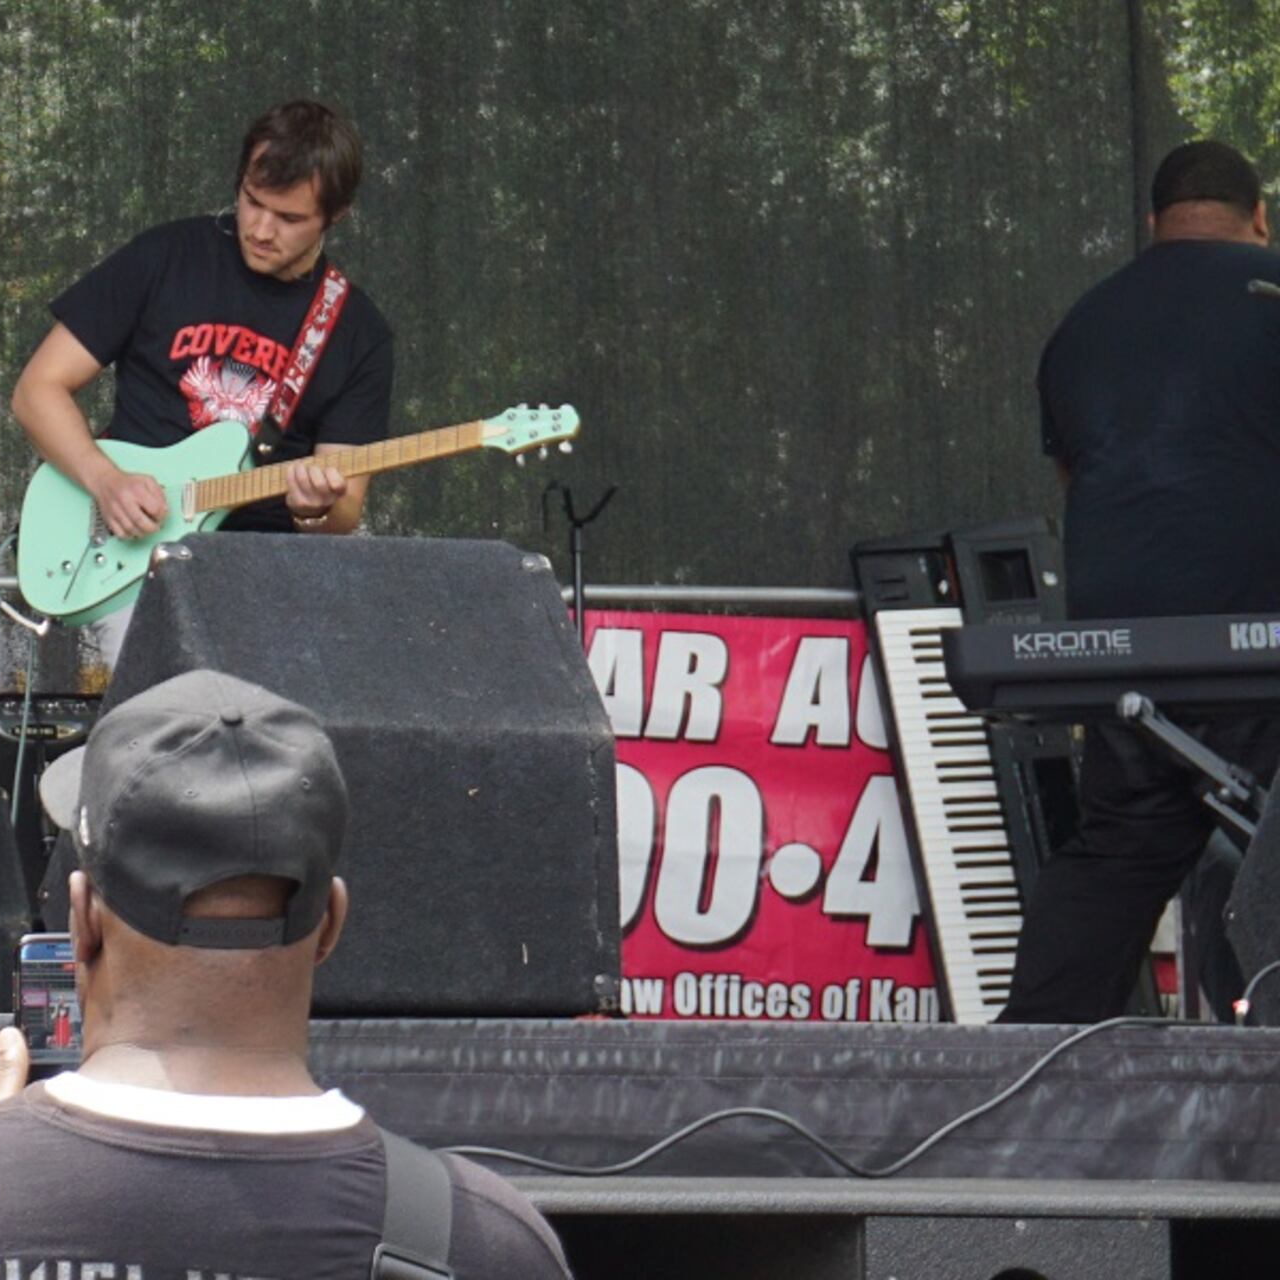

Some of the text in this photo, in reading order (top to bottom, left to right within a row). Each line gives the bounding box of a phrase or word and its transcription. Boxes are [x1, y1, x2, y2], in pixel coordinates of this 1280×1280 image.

[1013, 628, 1131, 652] KROME
[673, 971, 810, 1019] Offices
[821, 978, 860, 1020] of
